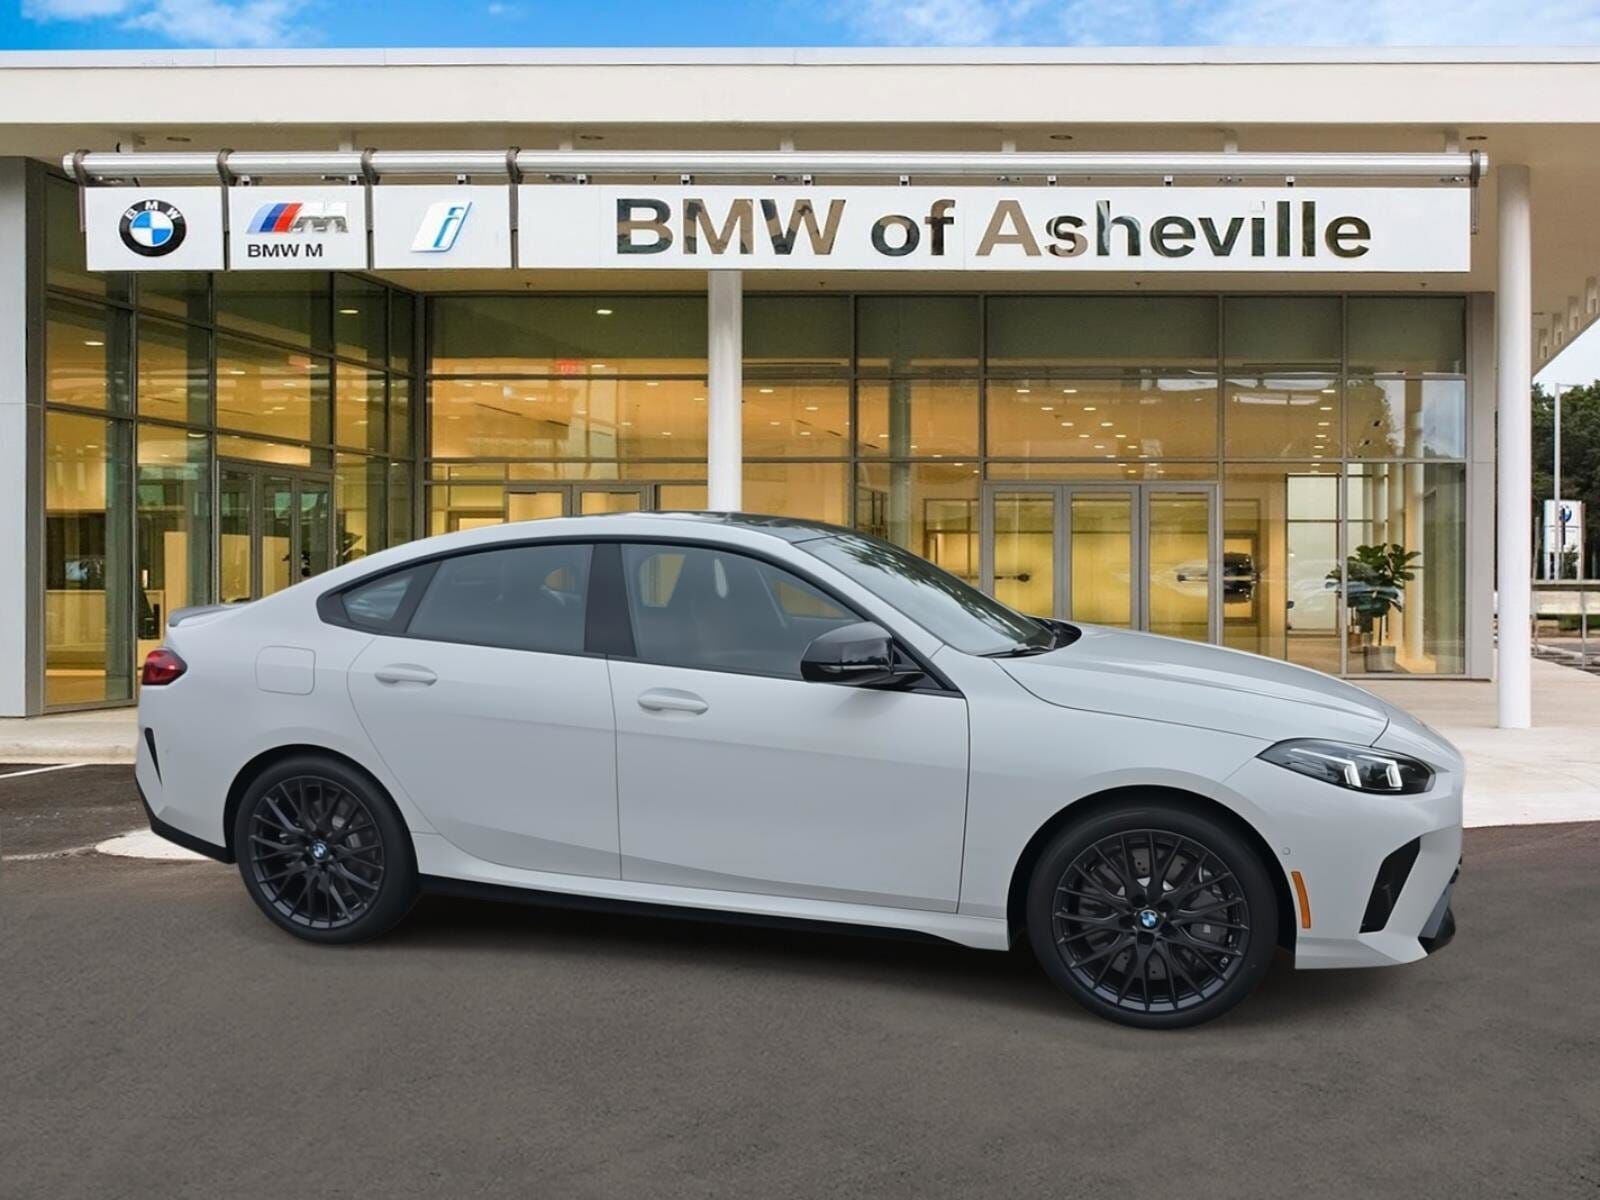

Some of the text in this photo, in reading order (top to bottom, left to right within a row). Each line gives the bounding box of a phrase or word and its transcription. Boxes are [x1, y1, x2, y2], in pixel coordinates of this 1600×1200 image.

[125, 200, 181, 220] BMW
[616, 198, 1372, 259] BMW of Asheville
[247, 244, 323, 257] BMW M
